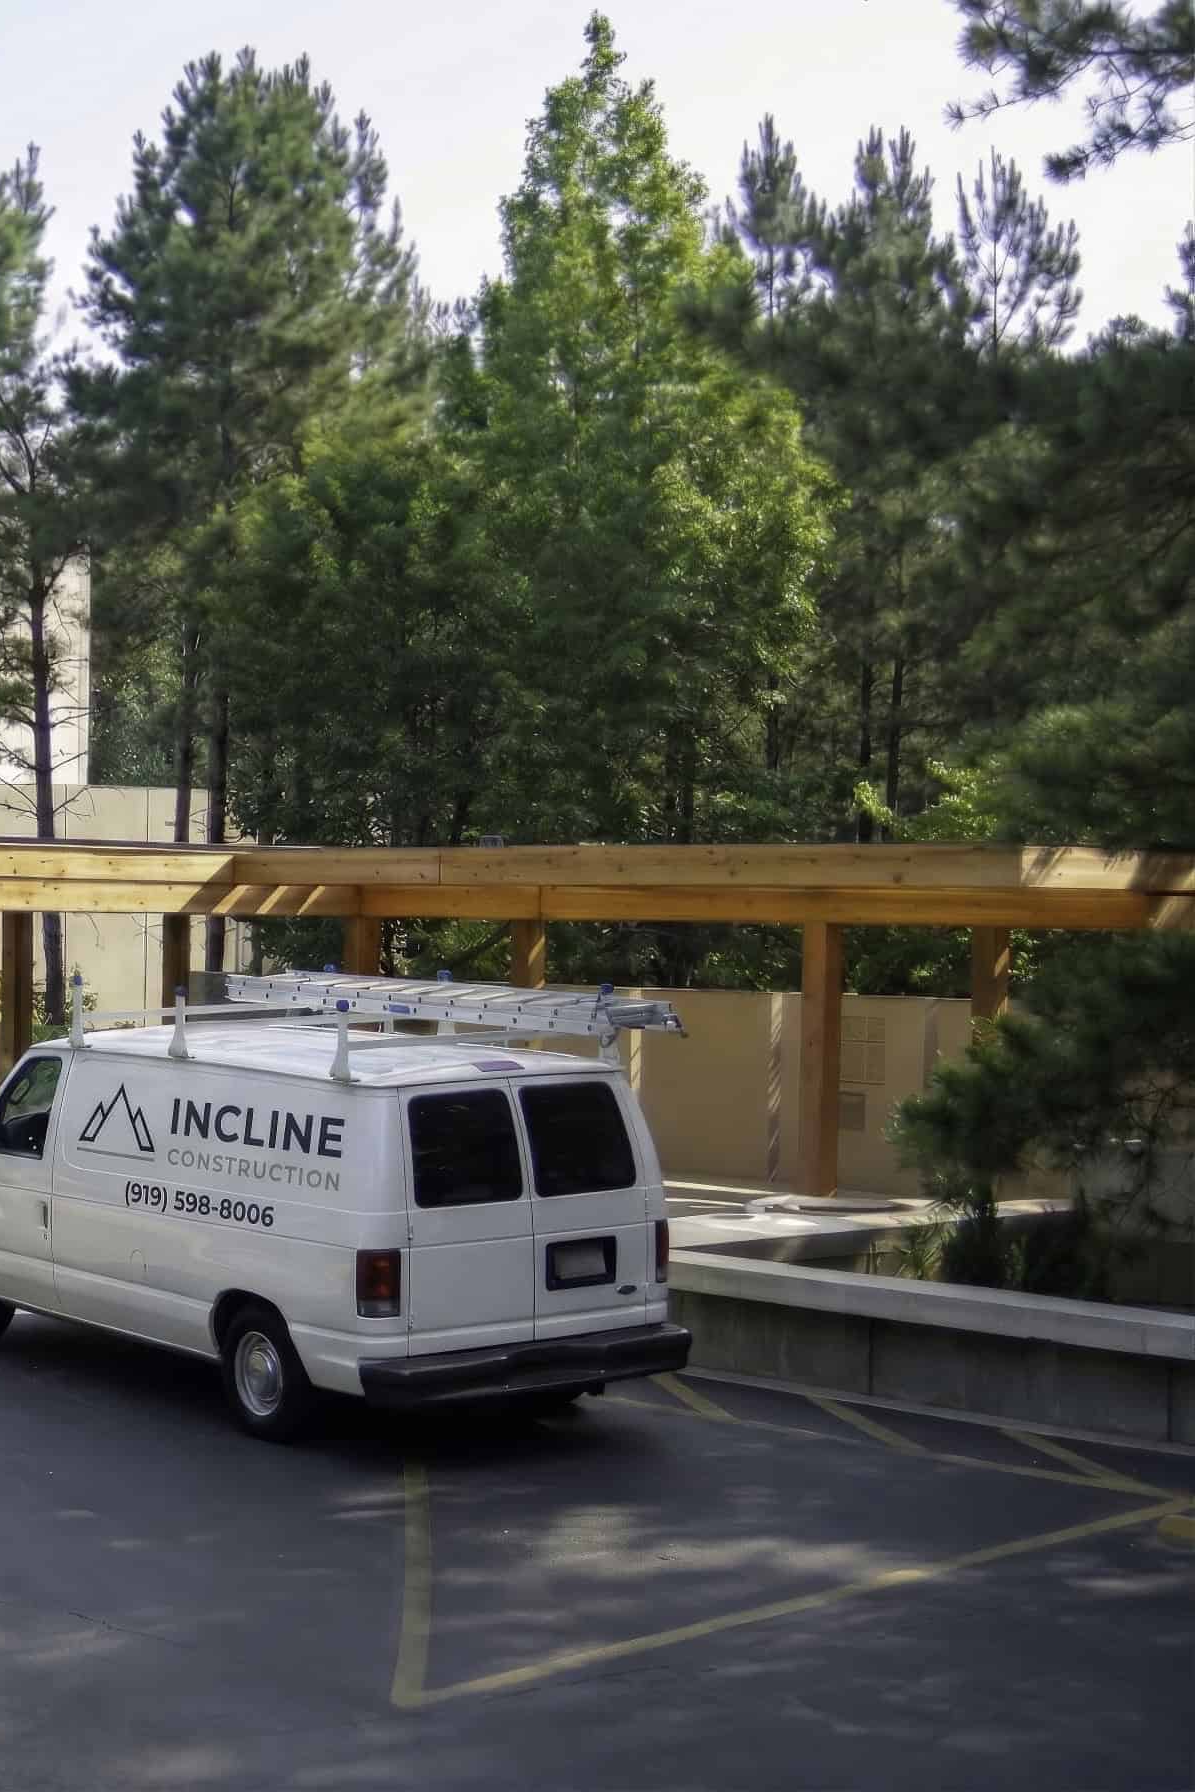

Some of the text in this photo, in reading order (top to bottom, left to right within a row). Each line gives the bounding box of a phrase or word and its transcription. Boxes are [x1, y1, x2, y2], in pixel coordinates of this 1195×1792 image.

[170, 1098, 345, 1158] INCLINE
[167, 1149, 341, 1192] CONSTRUCTION
[125, 1181, 275, 1227] (919) 598-8006
